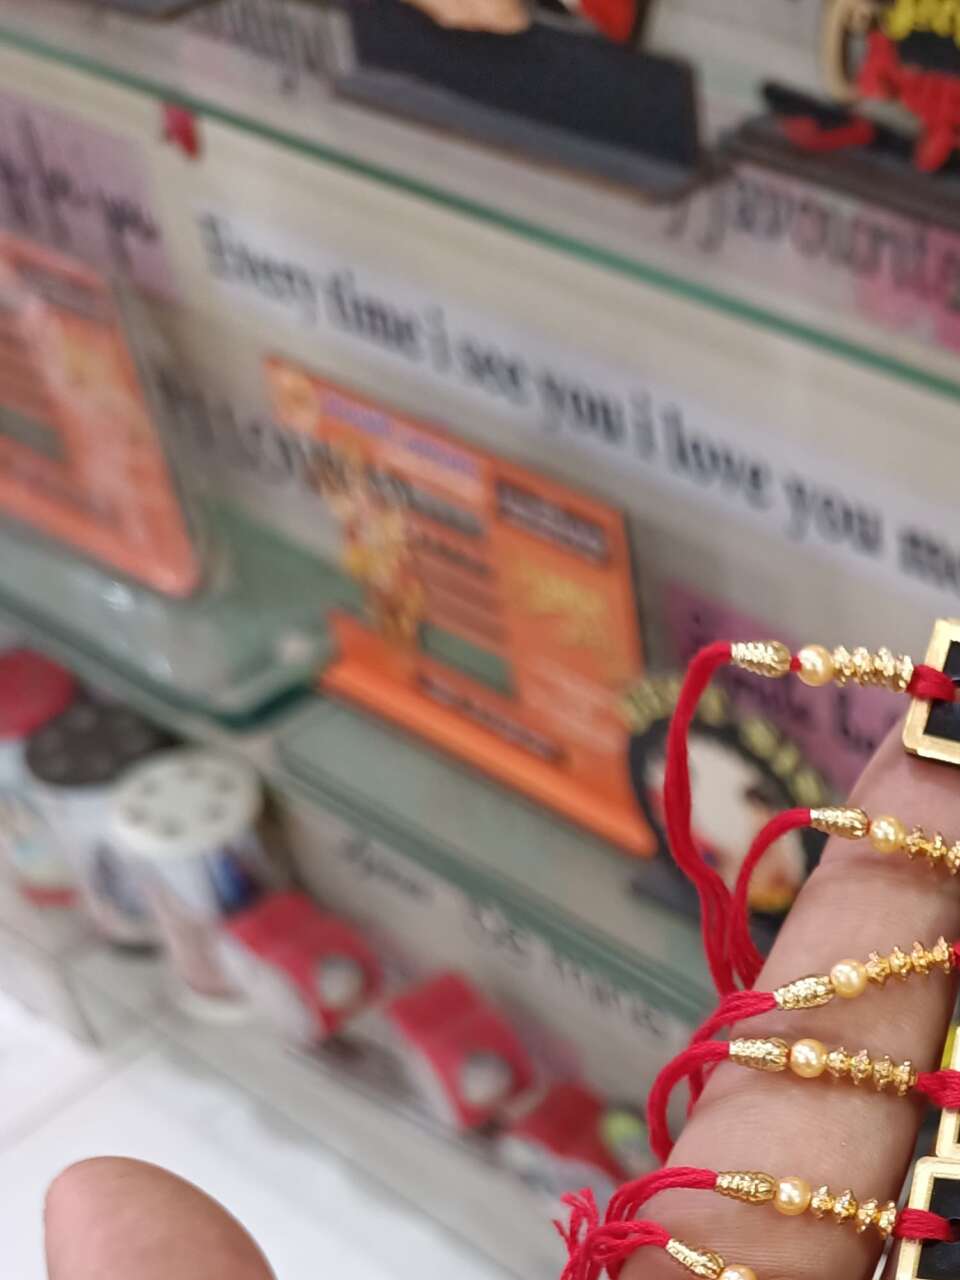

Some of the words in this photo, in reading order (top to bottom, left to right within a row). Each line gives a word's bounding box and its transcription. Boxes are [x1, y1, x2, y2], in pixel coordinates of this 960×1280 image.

[538, 370, 628, 446] you
[662, 404, 766, 506] love
[782, 474, 884, 558] you
